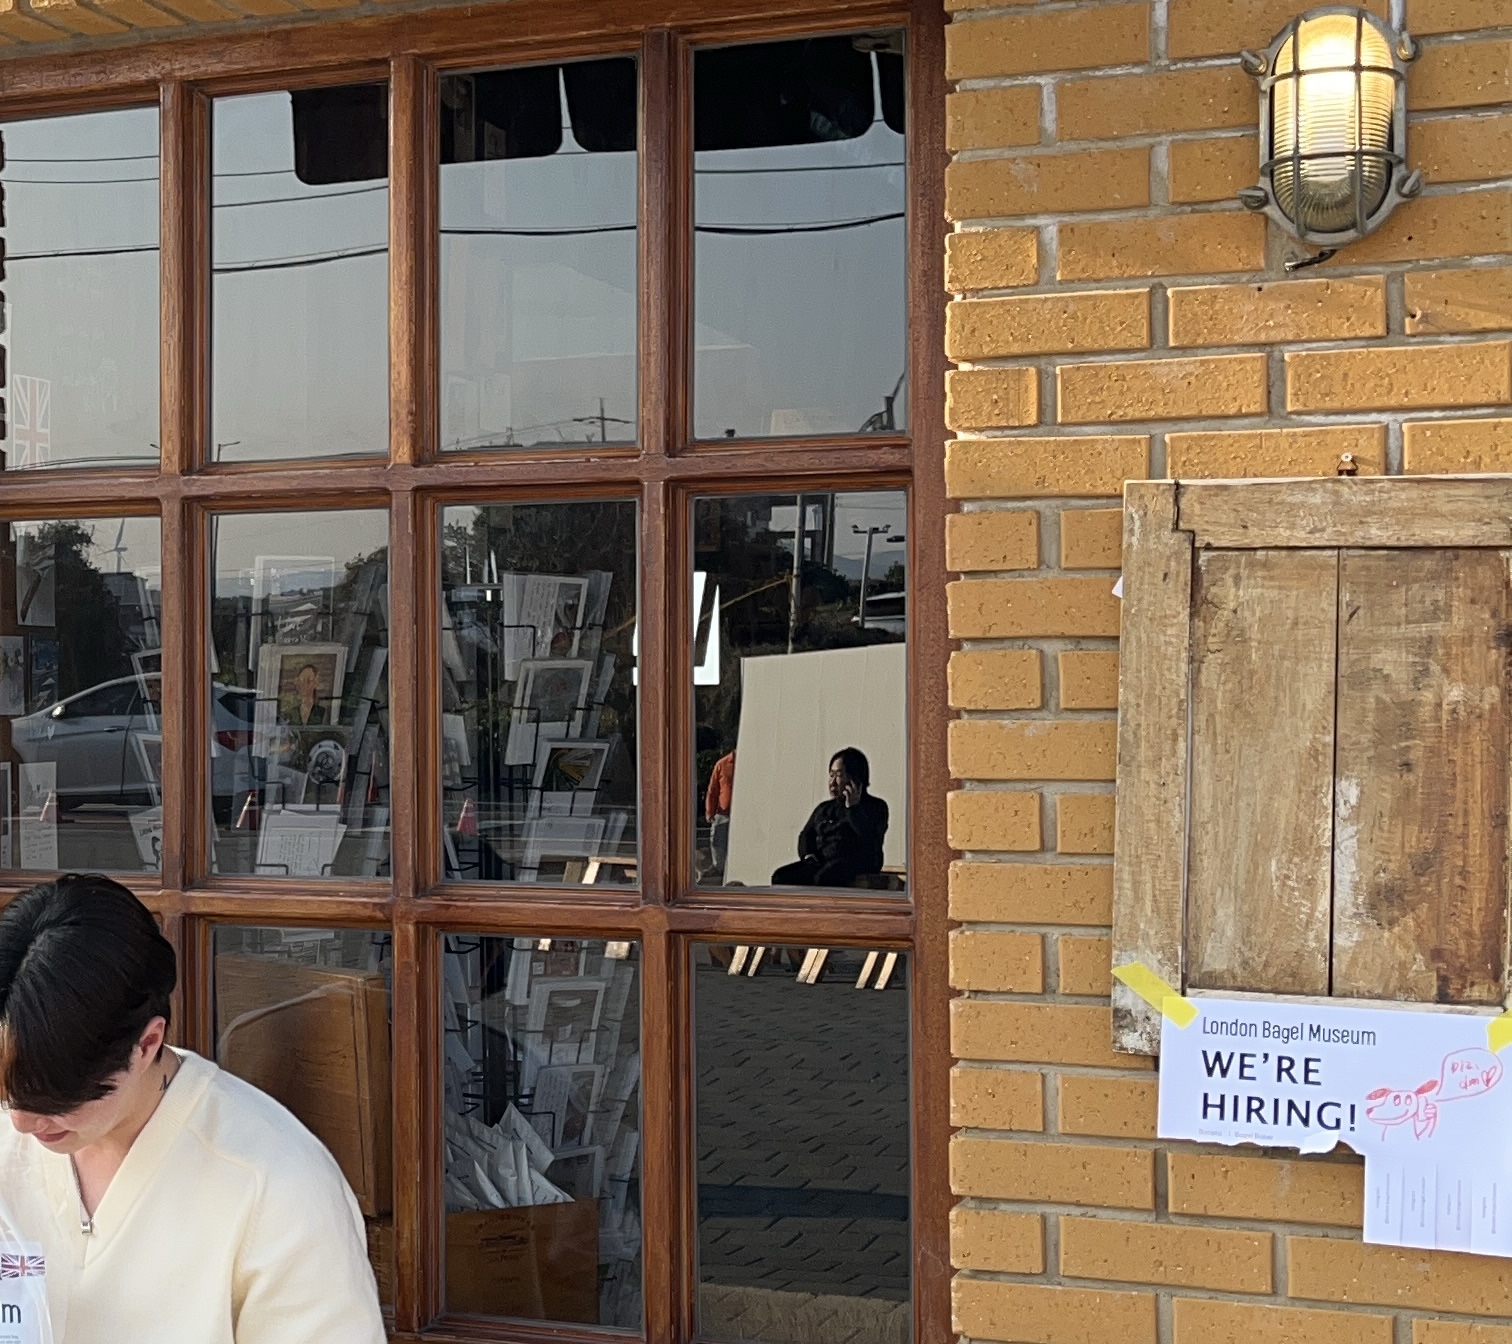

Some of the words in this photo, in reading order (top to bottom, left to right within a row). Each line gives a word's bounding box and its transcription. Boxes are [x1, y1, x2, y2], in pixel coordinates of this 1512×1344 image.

[1203, 1017, 1257, 1037] London
[1262, 1021, 1304, 1044] Bagel
[1309, 1024, 1376, 1046] Museum
[1201, 1050, 1322, 1086] WE’RE
[1202, 1092, 1356, 1132] HIRING!
